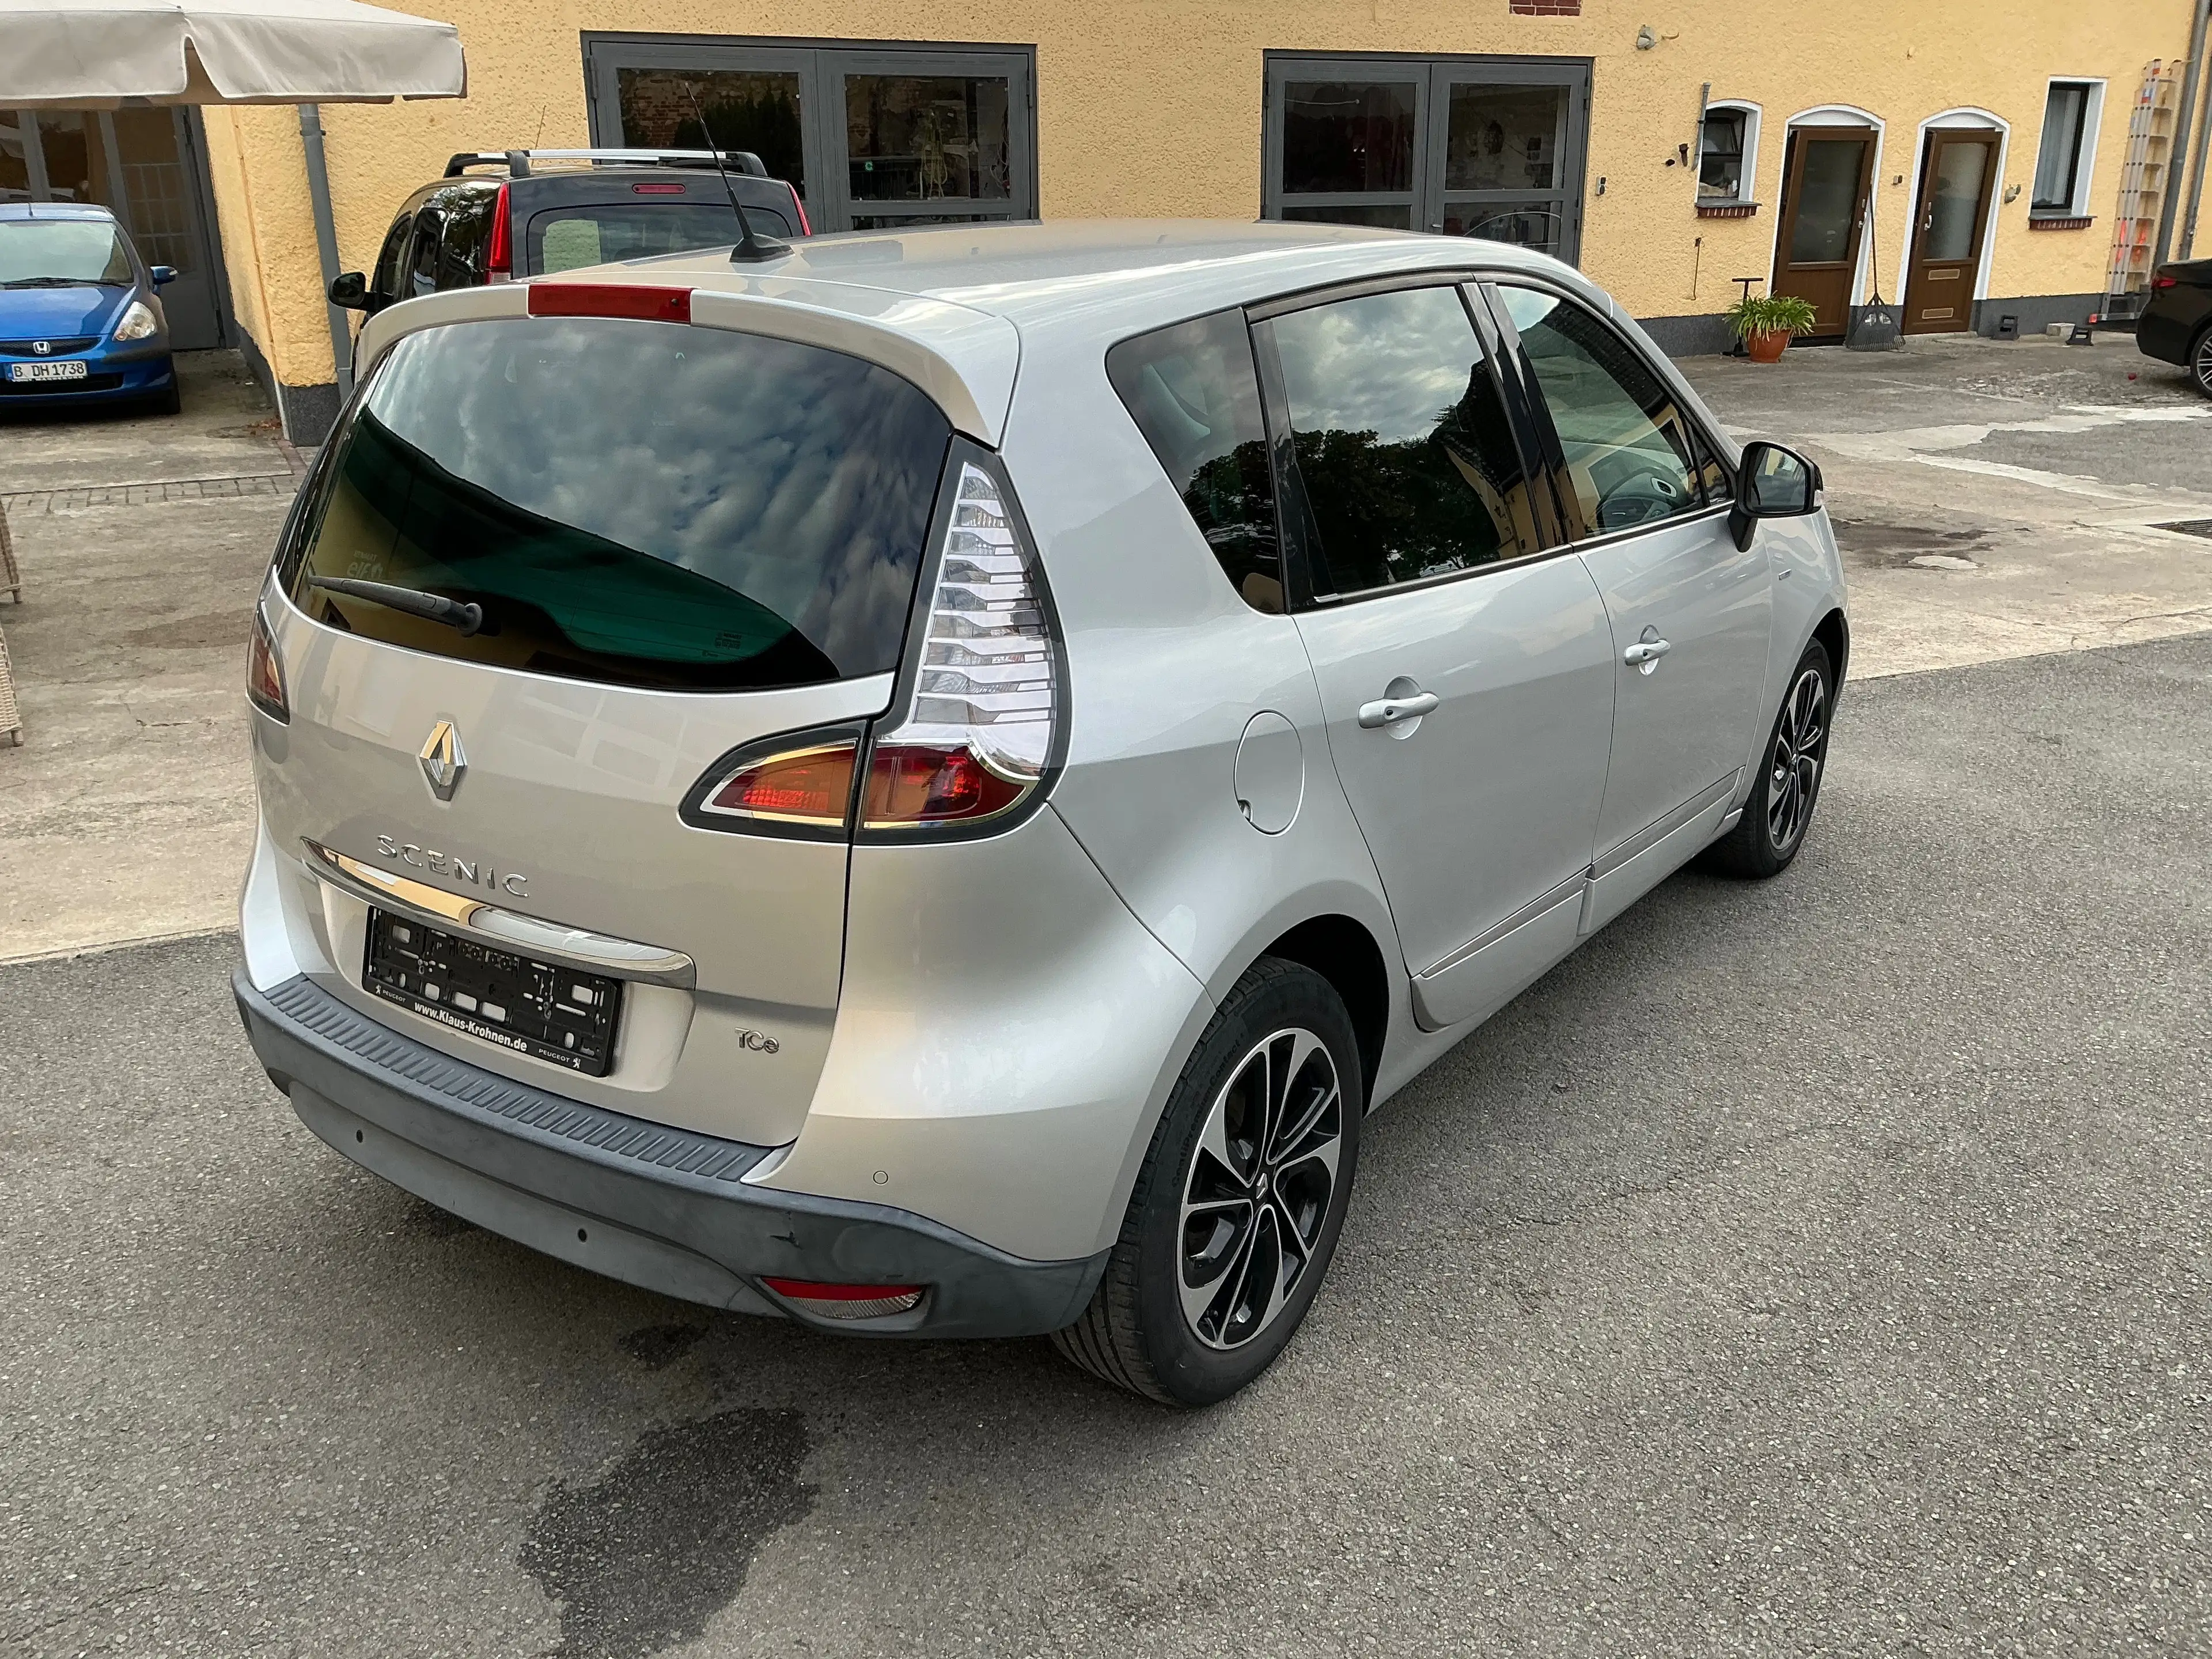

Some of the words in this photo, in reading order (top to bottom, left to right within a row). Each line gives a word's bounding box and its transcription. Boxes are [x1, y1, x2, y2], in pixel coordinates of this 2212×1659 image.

[14, 366, 23, 377] B
[377, 834, 528, 897] SCENIC
[382, 989, 406, 1003] PEUGEOT
[414, 1002, 527, 1052] www.Klaus-Krohnen.de
[734, 1027, 779, 1054] TCe
[539, 1048, 570, 1063] PEUGEOT
